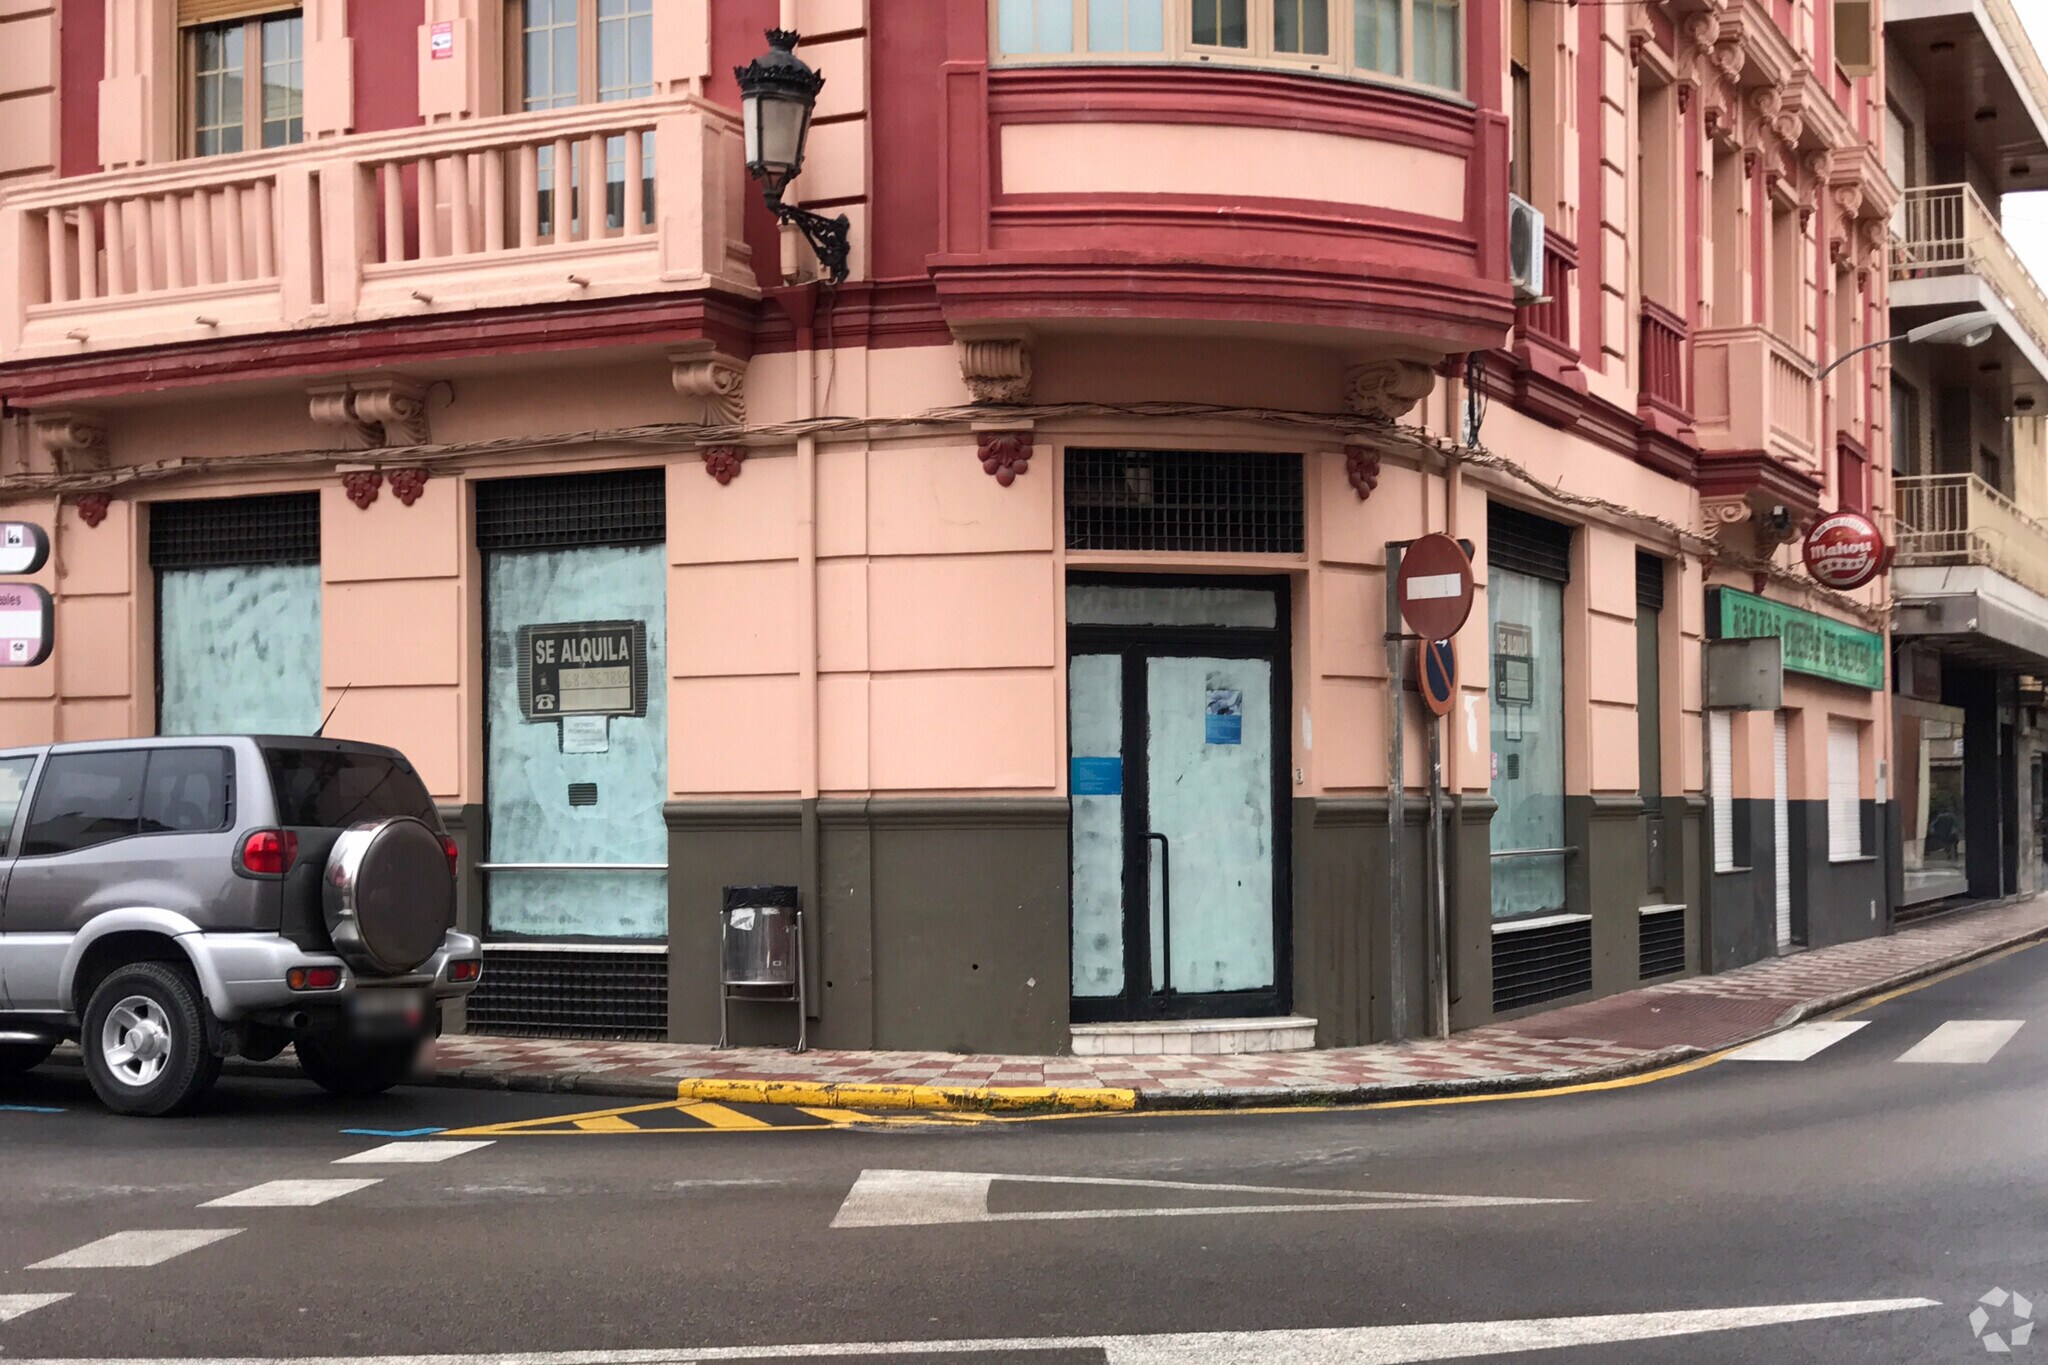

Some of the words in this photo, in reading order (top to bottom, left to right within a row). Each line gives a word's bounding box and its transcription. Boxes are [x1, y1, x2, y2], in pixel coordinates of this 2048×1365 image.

[1809, 541, 1873, 560] Mahou
[535, 639, 555, 664] SE
[560, 636, 629, 663] ALQUILA
